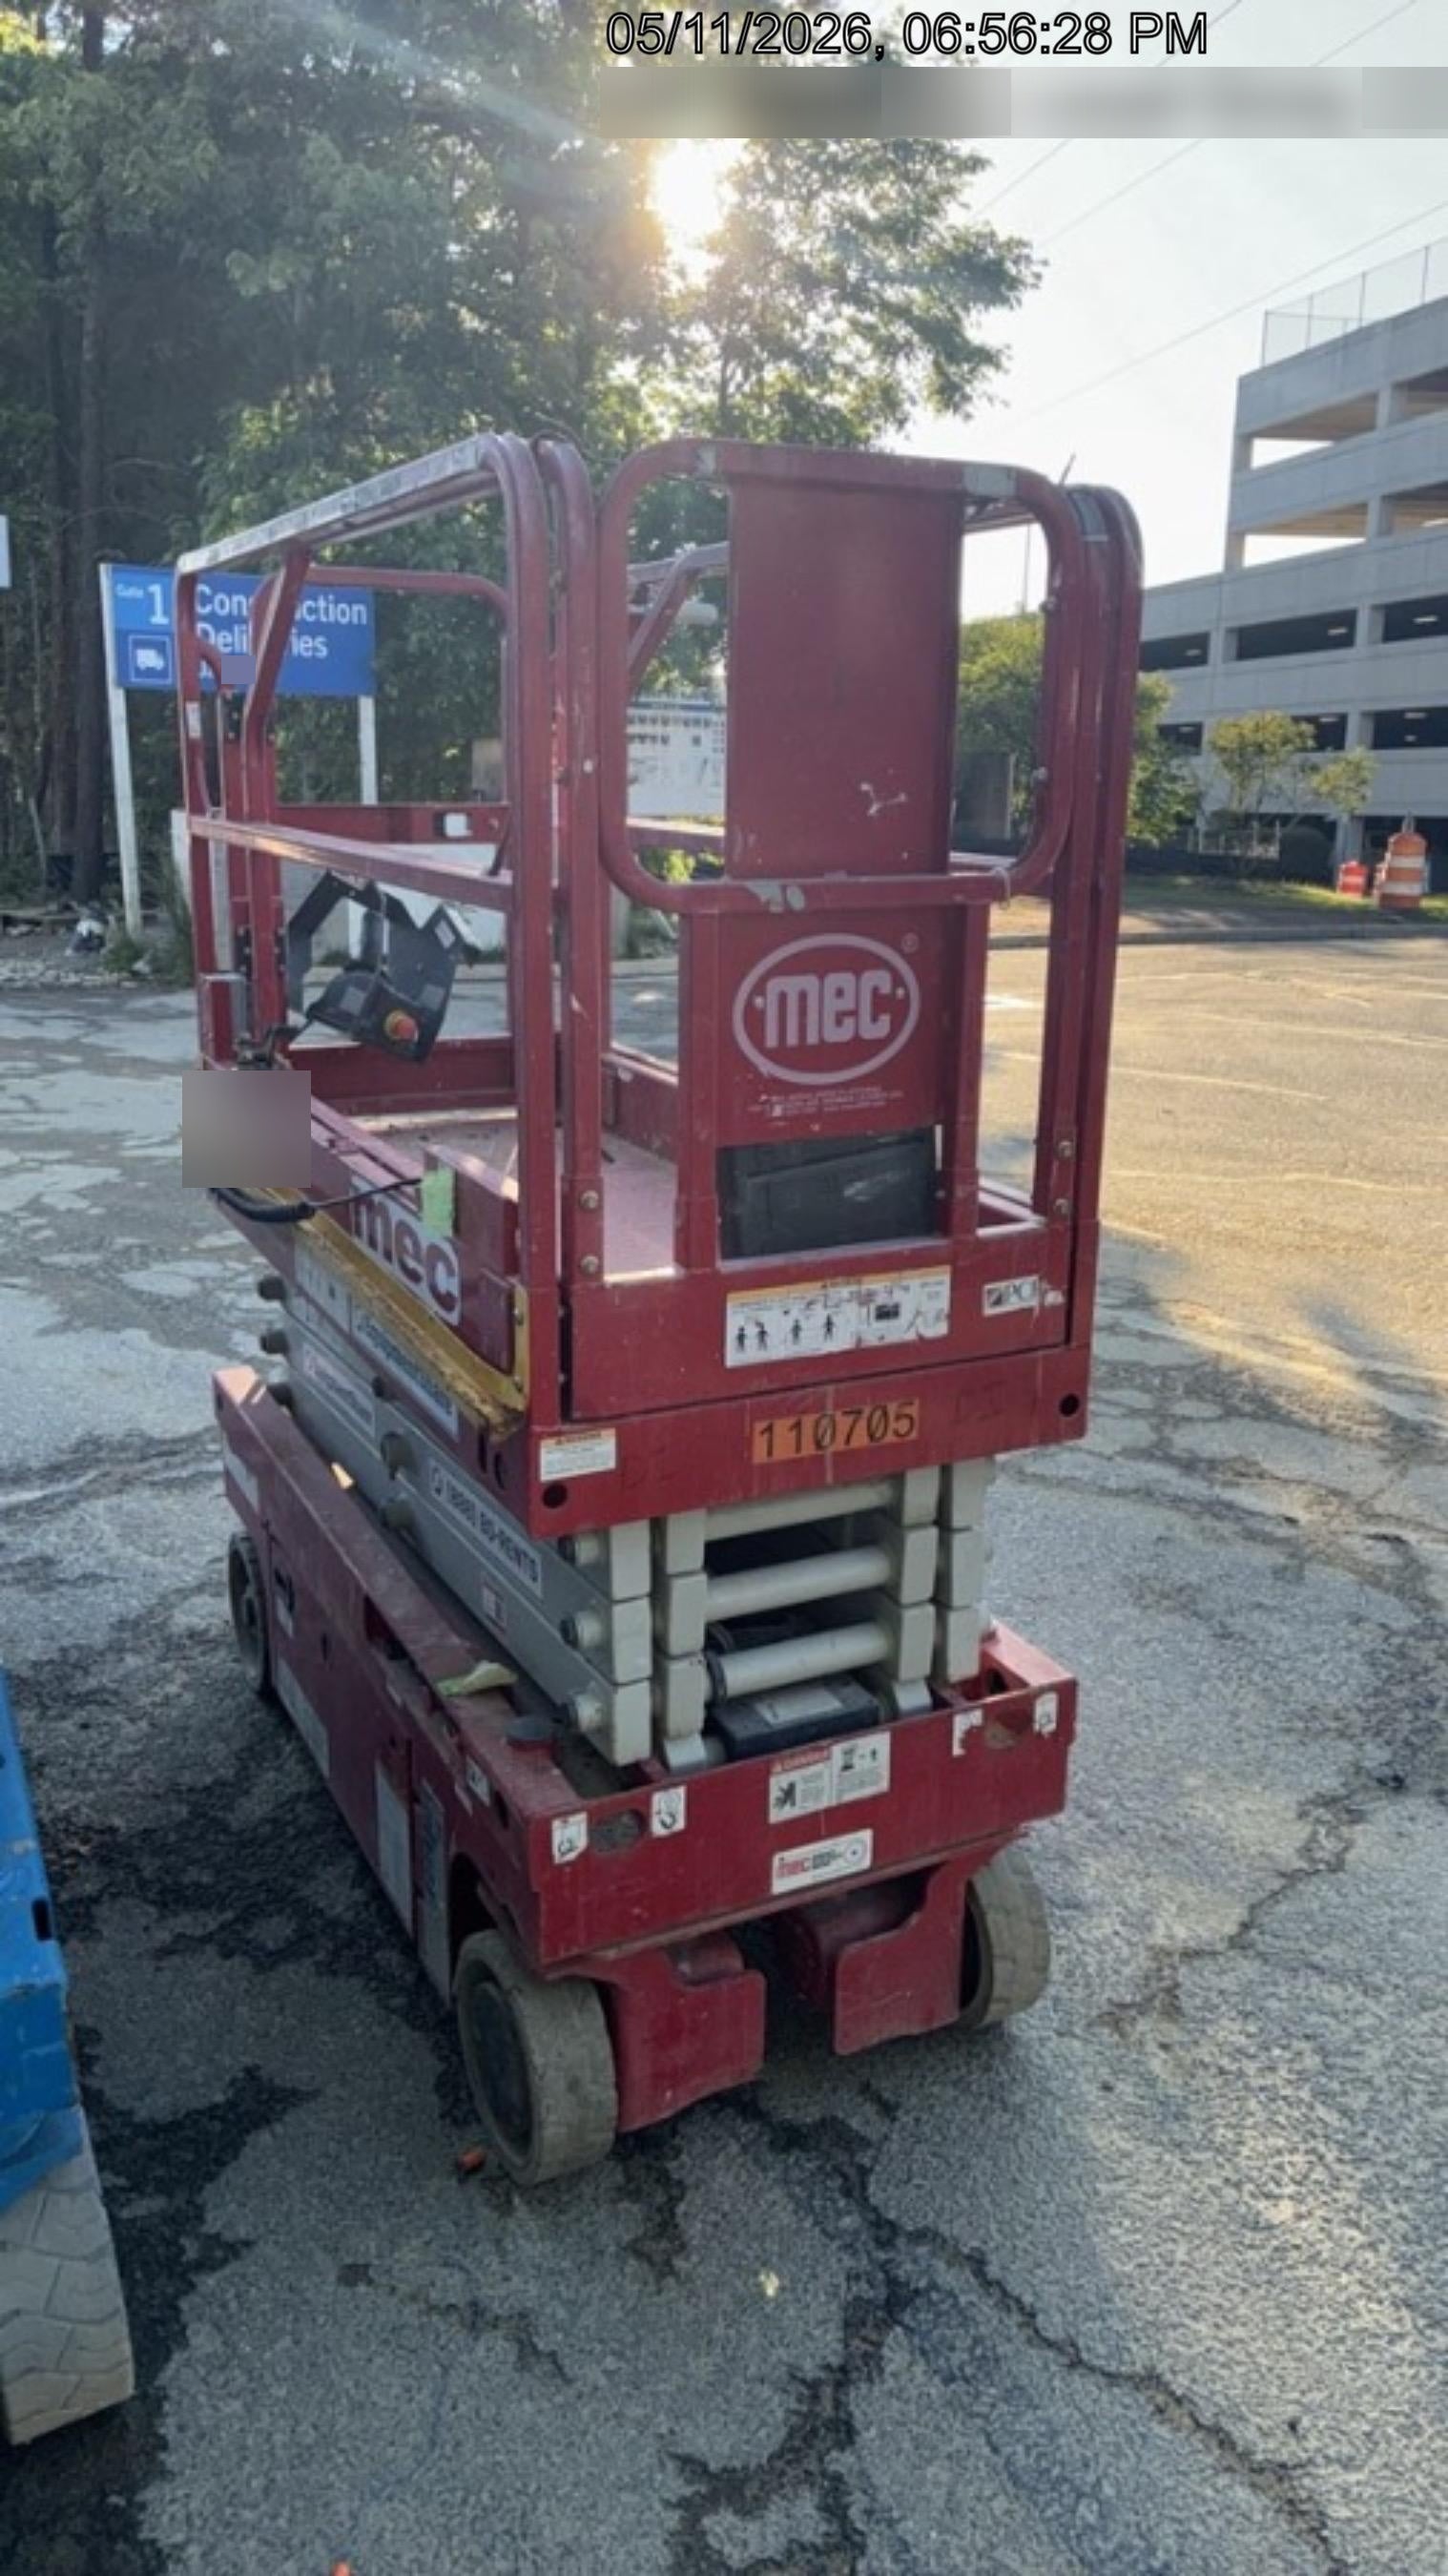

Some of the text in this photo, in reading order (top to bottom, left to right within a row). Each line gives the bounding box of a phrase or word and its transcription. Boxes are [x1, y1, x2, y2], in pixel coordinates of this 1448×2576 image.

[147, 583, 169, 625] 1
[195, 583, 367, 625] Conction
[764, 969, 893, 1049] mec
[353, 1196, 457, 1313] mec
[758, 1401, 915, 1459] 110705
